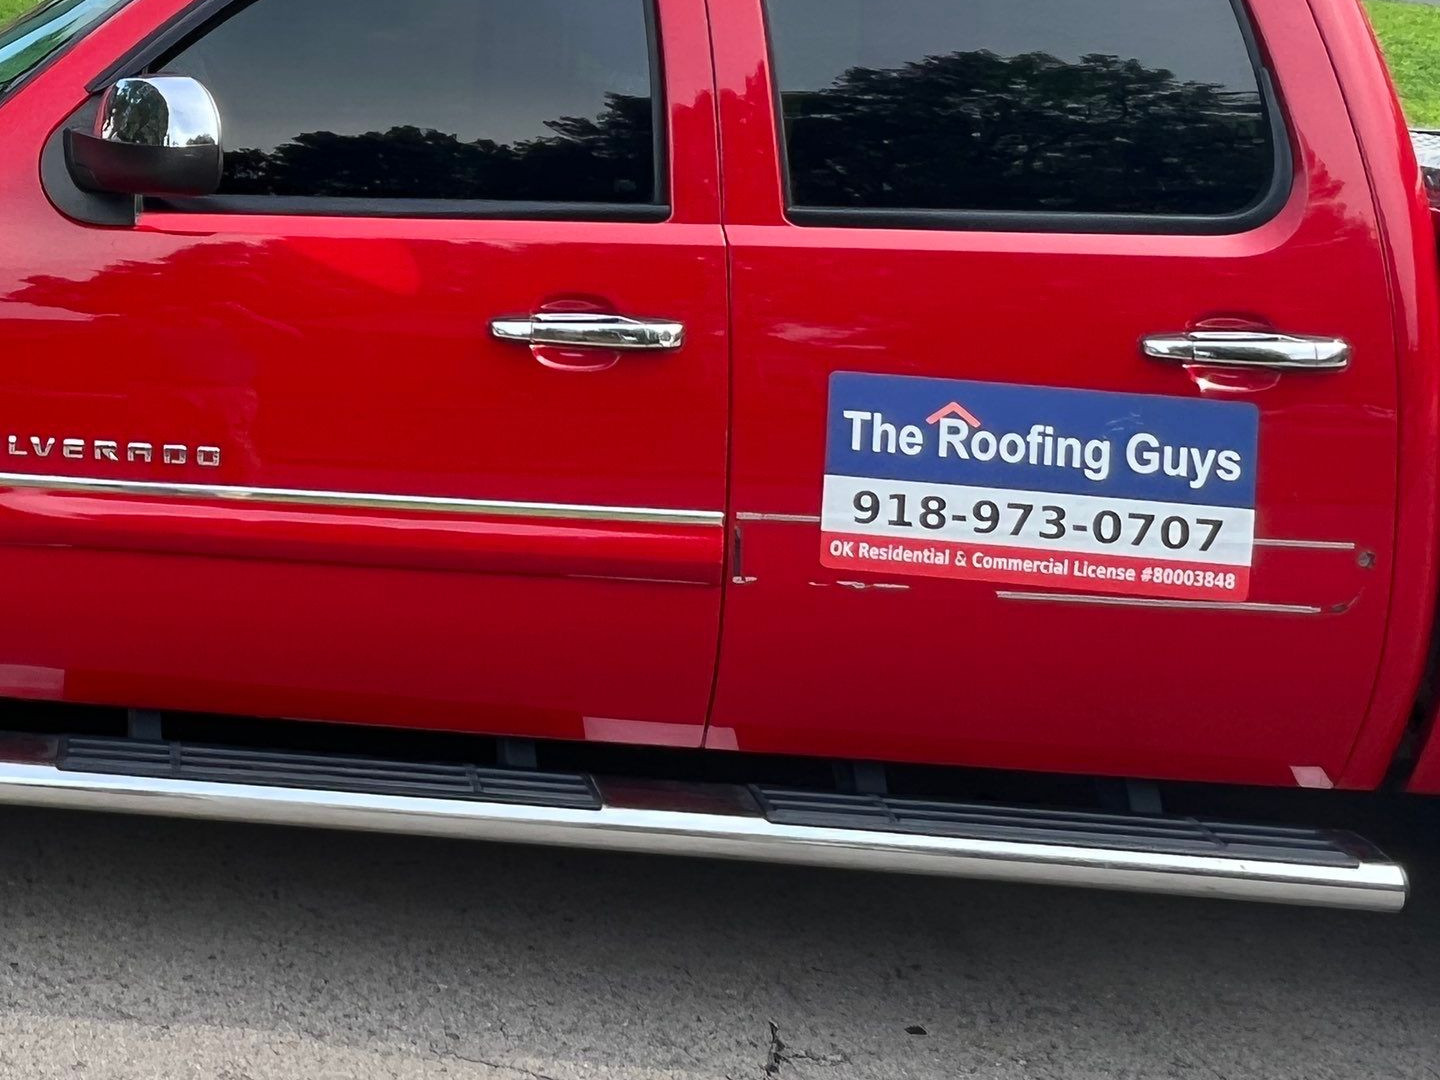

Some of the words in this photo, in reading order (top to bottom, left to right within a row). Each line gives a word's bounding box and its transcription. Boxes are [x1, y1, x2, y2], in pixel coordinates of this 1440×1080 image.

[843, 410, 924, 456] The
[937, 417, 1111, 481] Roofing
[1126, 432, 1241, 489] Guys
[852, 490, 1224, 553] 918-973-0707
[829, 539, 855, 558] OK
[858, 542, 950, 566] Residential
[955, 550, 967, 568] &
[971, 551, 1069, 576] Commercial
[1073, 560, 1136, 582] License
[1140, 566, 1236, 590] #80003848
